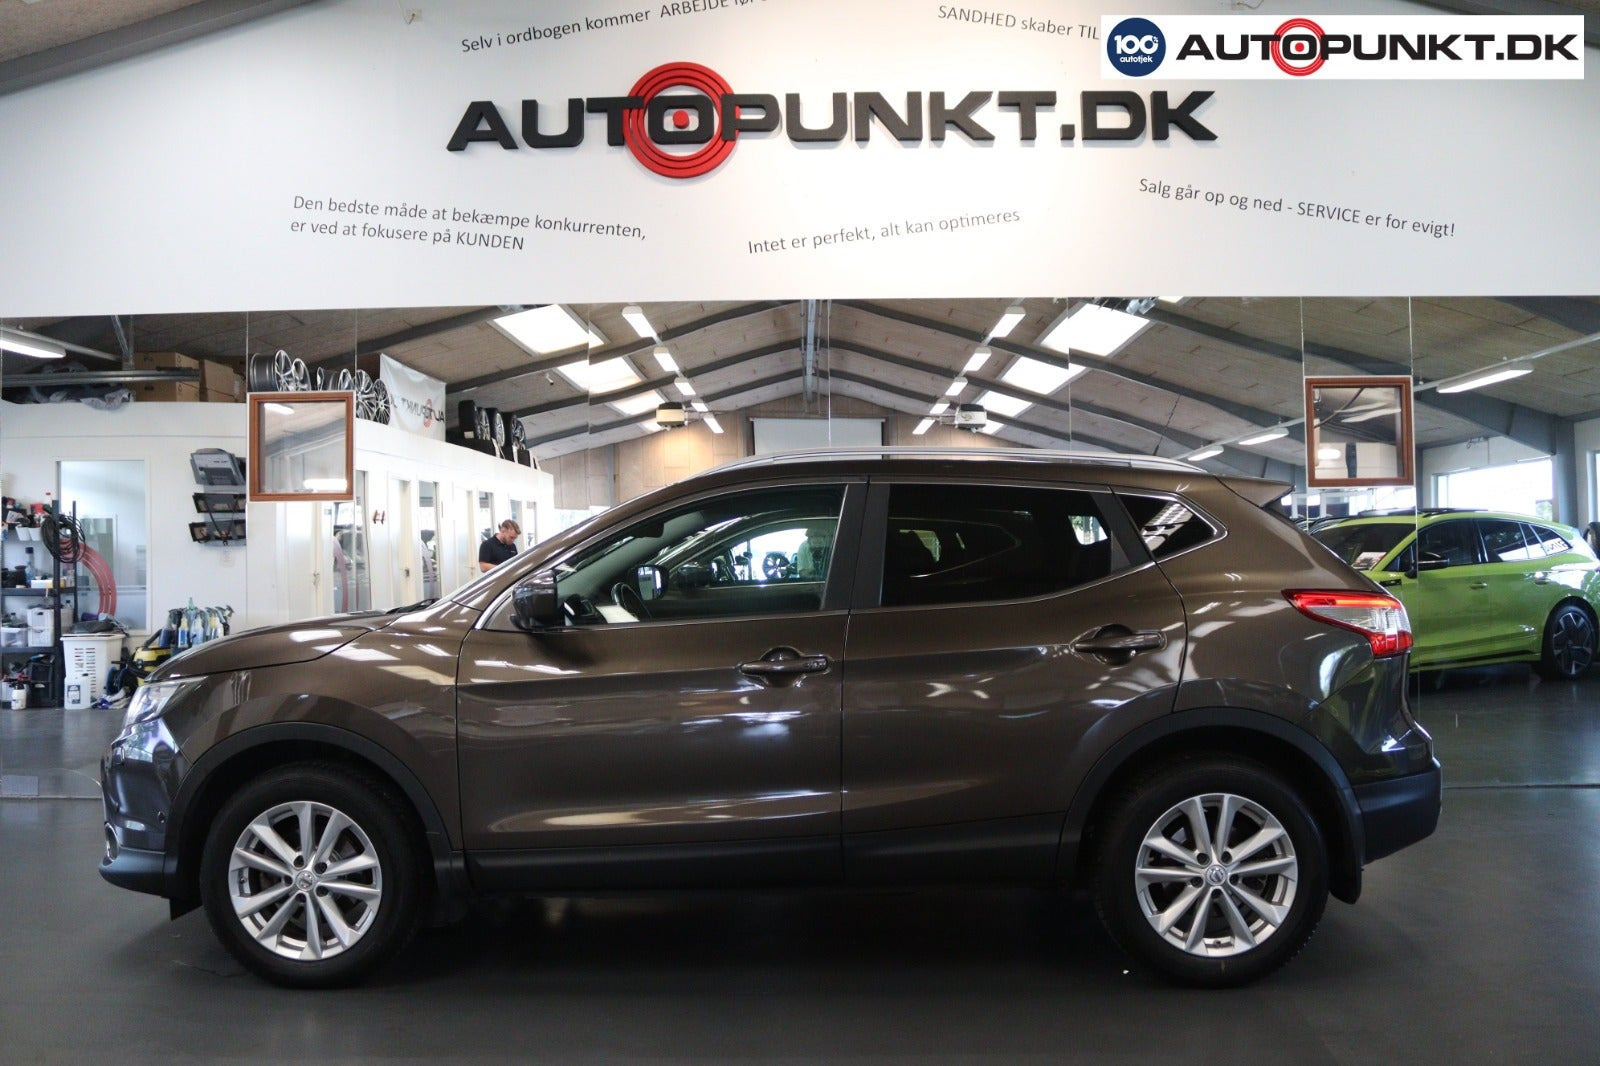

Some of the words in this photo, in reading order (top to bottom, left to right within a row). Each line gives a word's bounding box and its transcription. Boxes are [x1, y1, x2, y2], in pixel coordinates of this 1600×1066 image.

[462, 35, 493, 53] Selv
[497, 33, 502, 46] i
[506, 22, 581, 45] ordbogen
[585, 10, 651, 31] kommer
[660, 0, 729, 18] ARBEJDE
[938, 5, 1016, 28] SANDHED
[1021, 17, 1073, 36] skaber
[447, 90, 1218, 152] AUTOPUNKT.DK
[294, 196, 323, 211] Den
[328, 197, 380, 216] bedste
[384, 202, 428, 220] måde
[432, 208, 448, 221] at
[452, 207, 530, 230] bekæmpe
[535, 214, 646, 241] konkurrenten,
[1139, 178, 1171, 199] Salg
[1175, 184, 1201, 201] går
[1205, 191, 1225, 206] op
[1229, 194, 1249, 211] og
[1253, 197, 1283, 213] ned
[1297, 201, 1361, 224] SERVICE
[1365, 214, 1382, 227] er
[1386, 213, 1408, 231] for
[1412, 221, 1455, 239] evigt!
[290, 221, 307, 233] er
[311, 221, 338, 235] ved
[342, 224, 358, 237] at
[362, 222, 428, 242] fokusere
[432, 228, 452, 246] på
[457, 231, 525, 251] KUNDEN
[748, 237, 788, 255] Intet
[791, 236, 808, 249] er
[813, 226, 876, 250] perfekt,
[880, 222, 901, 238] alt
[905, 220, 934, 235] kan
[938, 209, 1021, 233] optimeres
